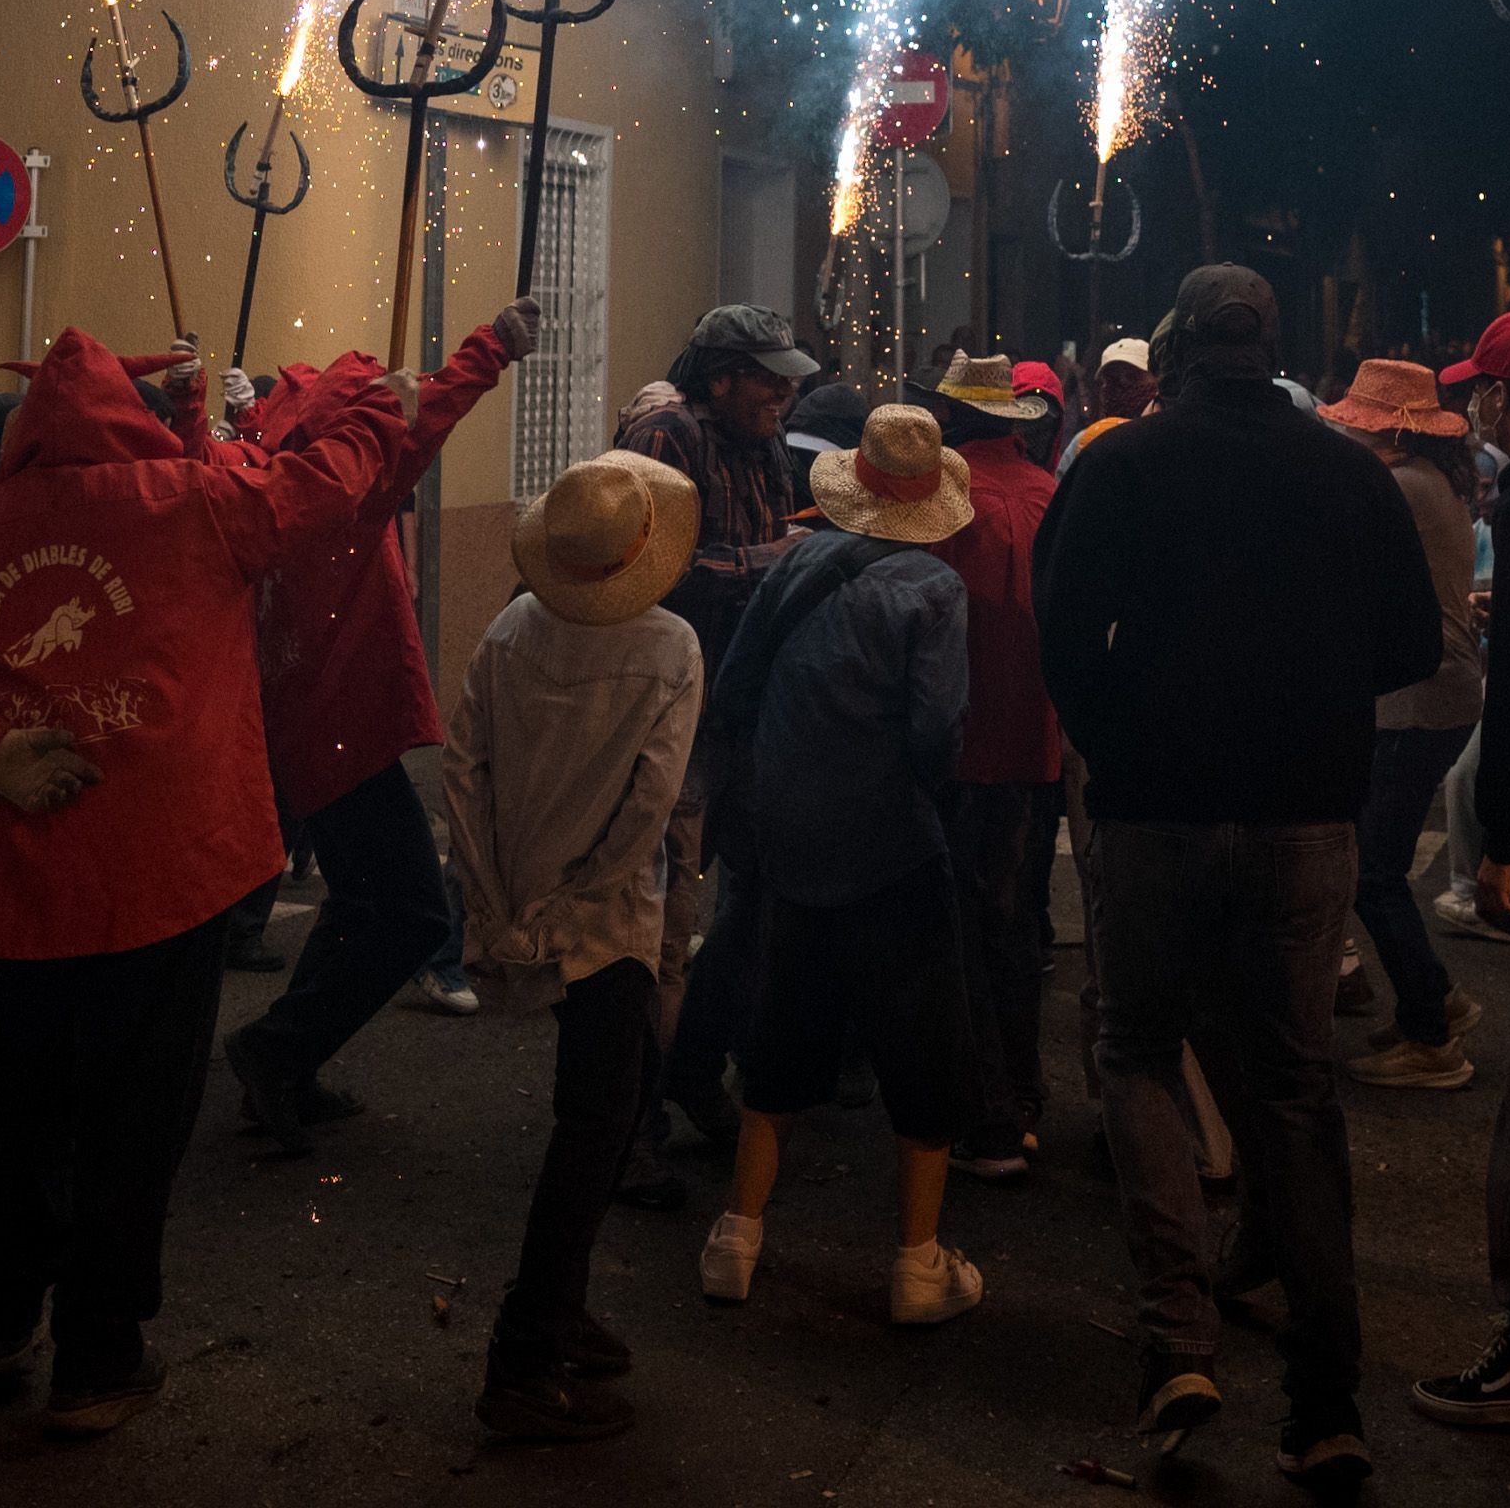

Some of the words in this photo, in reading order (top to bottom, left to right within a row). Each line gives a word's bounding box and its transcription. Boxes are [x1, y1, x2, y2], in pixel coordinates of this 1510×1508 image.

[449, 45, 523, 70] direcons
[22, 545, 87, 573] DIABLES
[89, 555, 112, 580] DE
